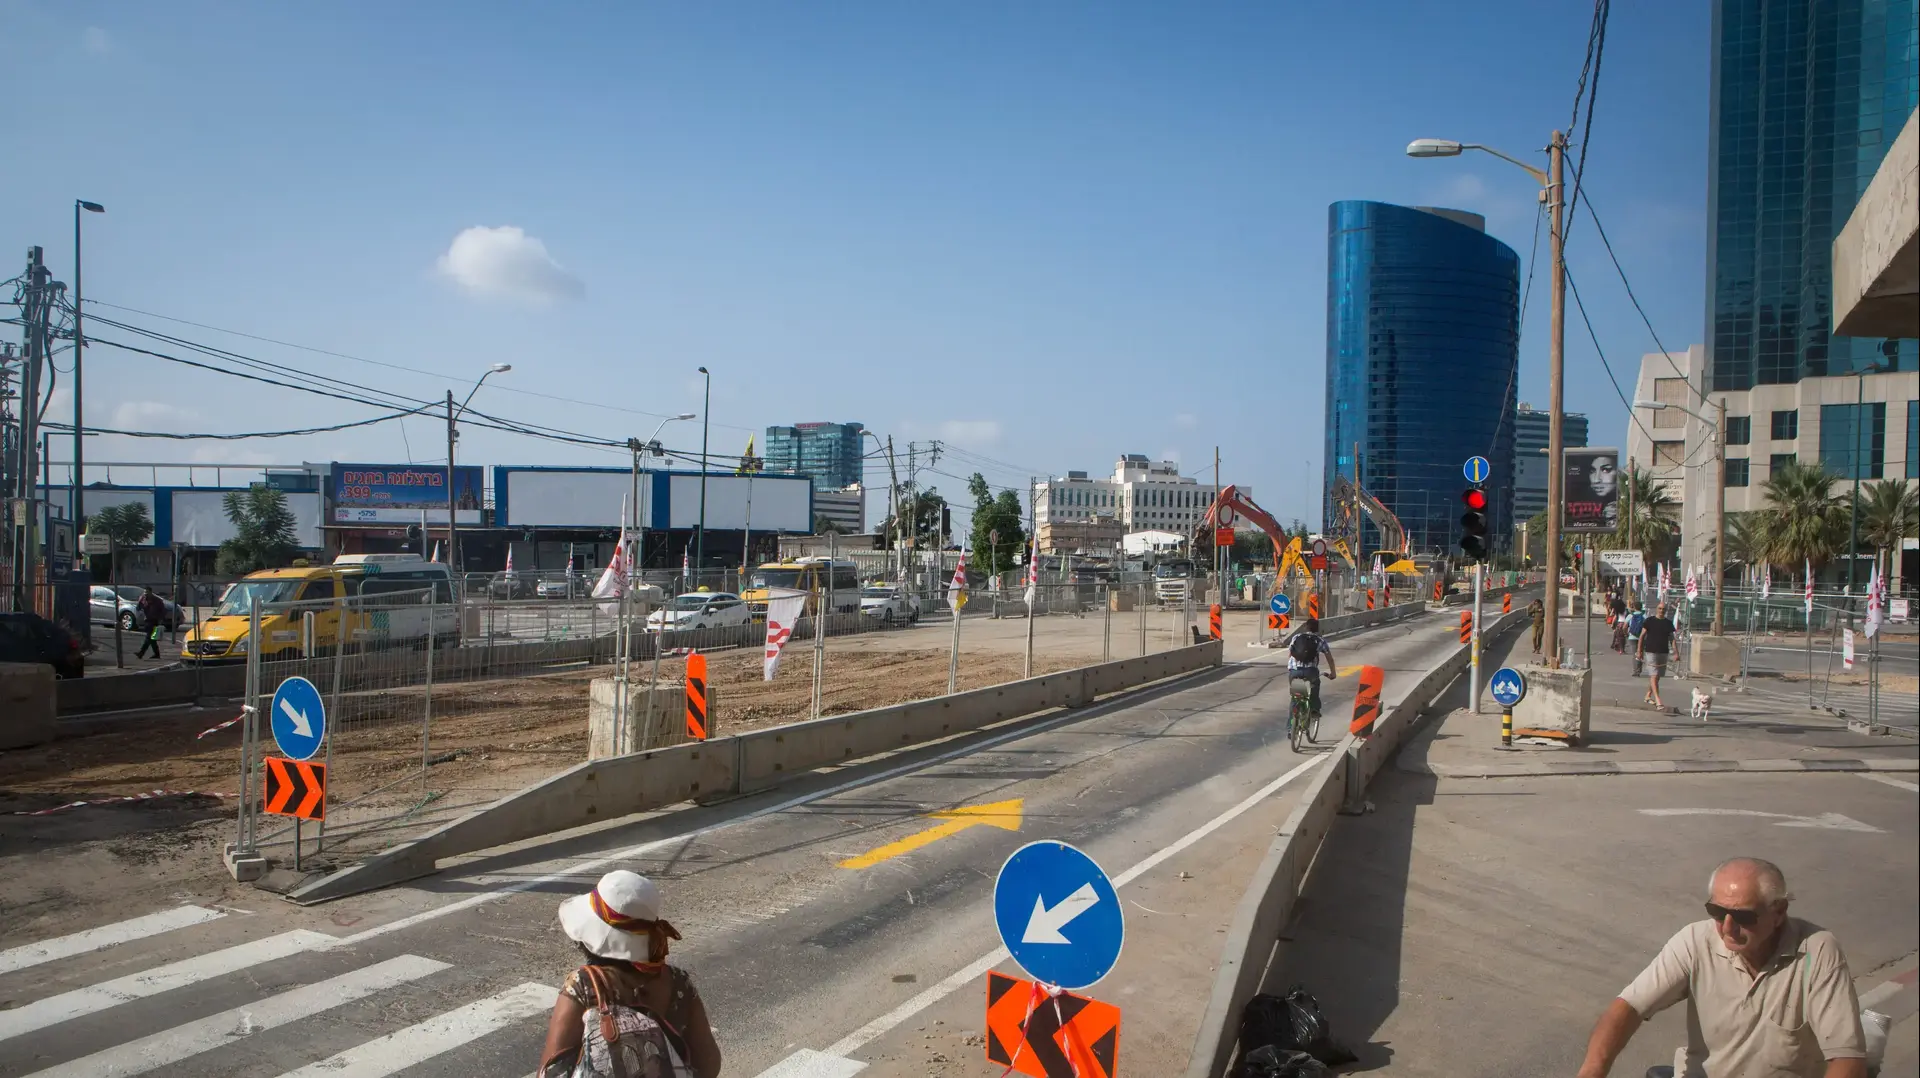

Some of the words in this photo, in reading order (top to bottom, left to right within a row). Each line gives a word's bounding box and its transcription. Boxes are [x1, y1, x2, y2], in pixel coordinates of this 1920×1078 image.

[344, 472, 384, 485] בחגים
[388, 471, 443, 486] ברצלונה
[1353, 495, 1373, 514] VLVO
